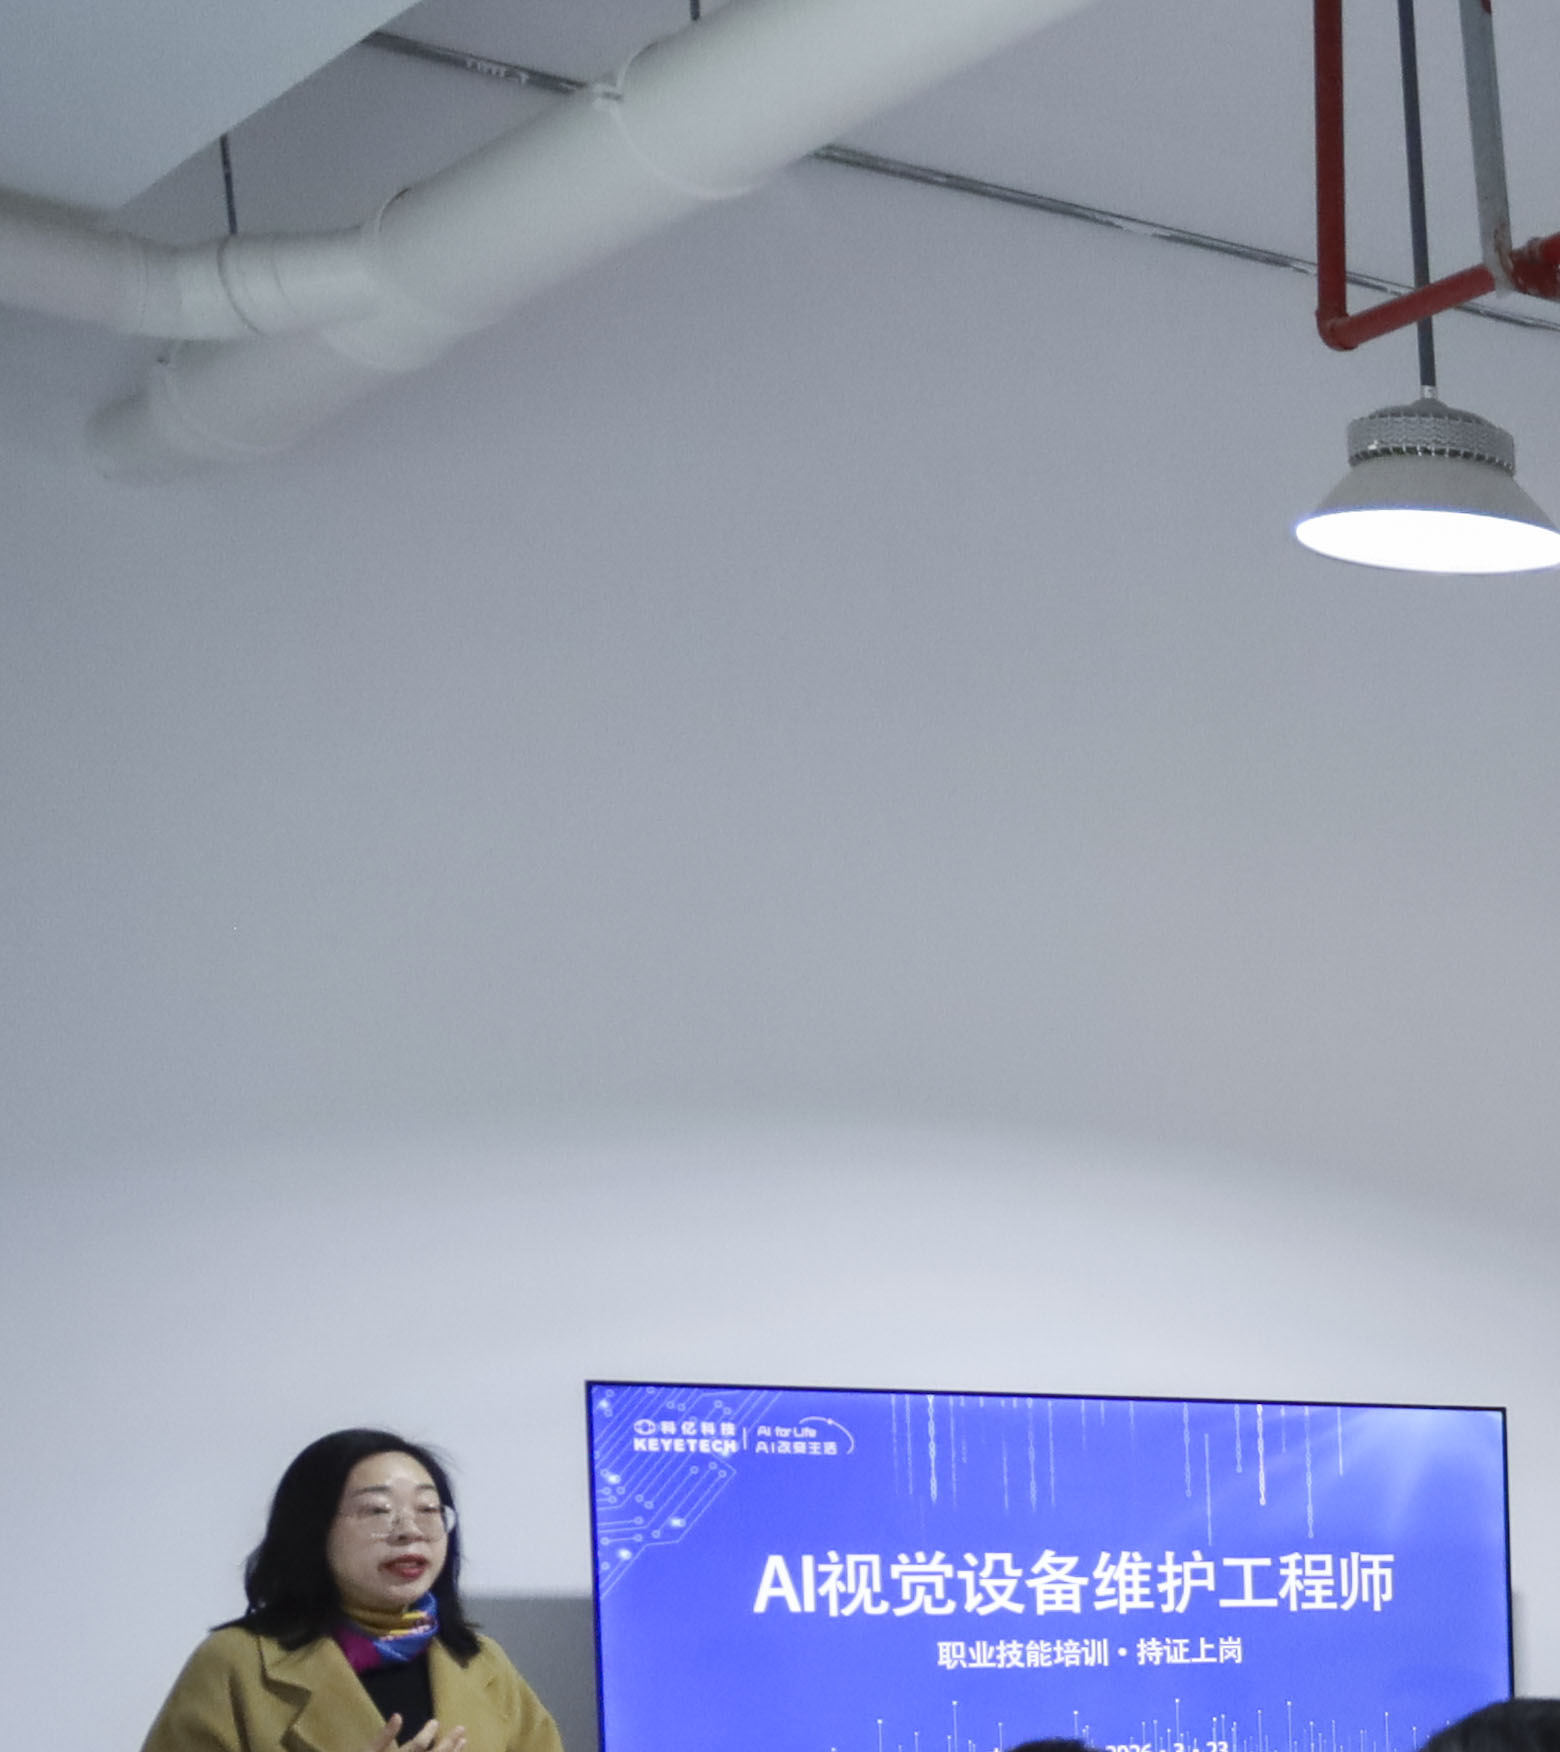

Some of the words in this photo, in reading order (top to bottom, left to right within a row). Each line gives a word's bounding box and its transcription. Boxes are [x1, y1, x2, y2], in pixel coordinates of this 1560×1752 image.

[660, 1420, 737, 1436] 科亿科技
[634, 1438, 739, 1453] KEYETECH
[753, 1549, 1396, 1617] AI视觉设备维护工程师
